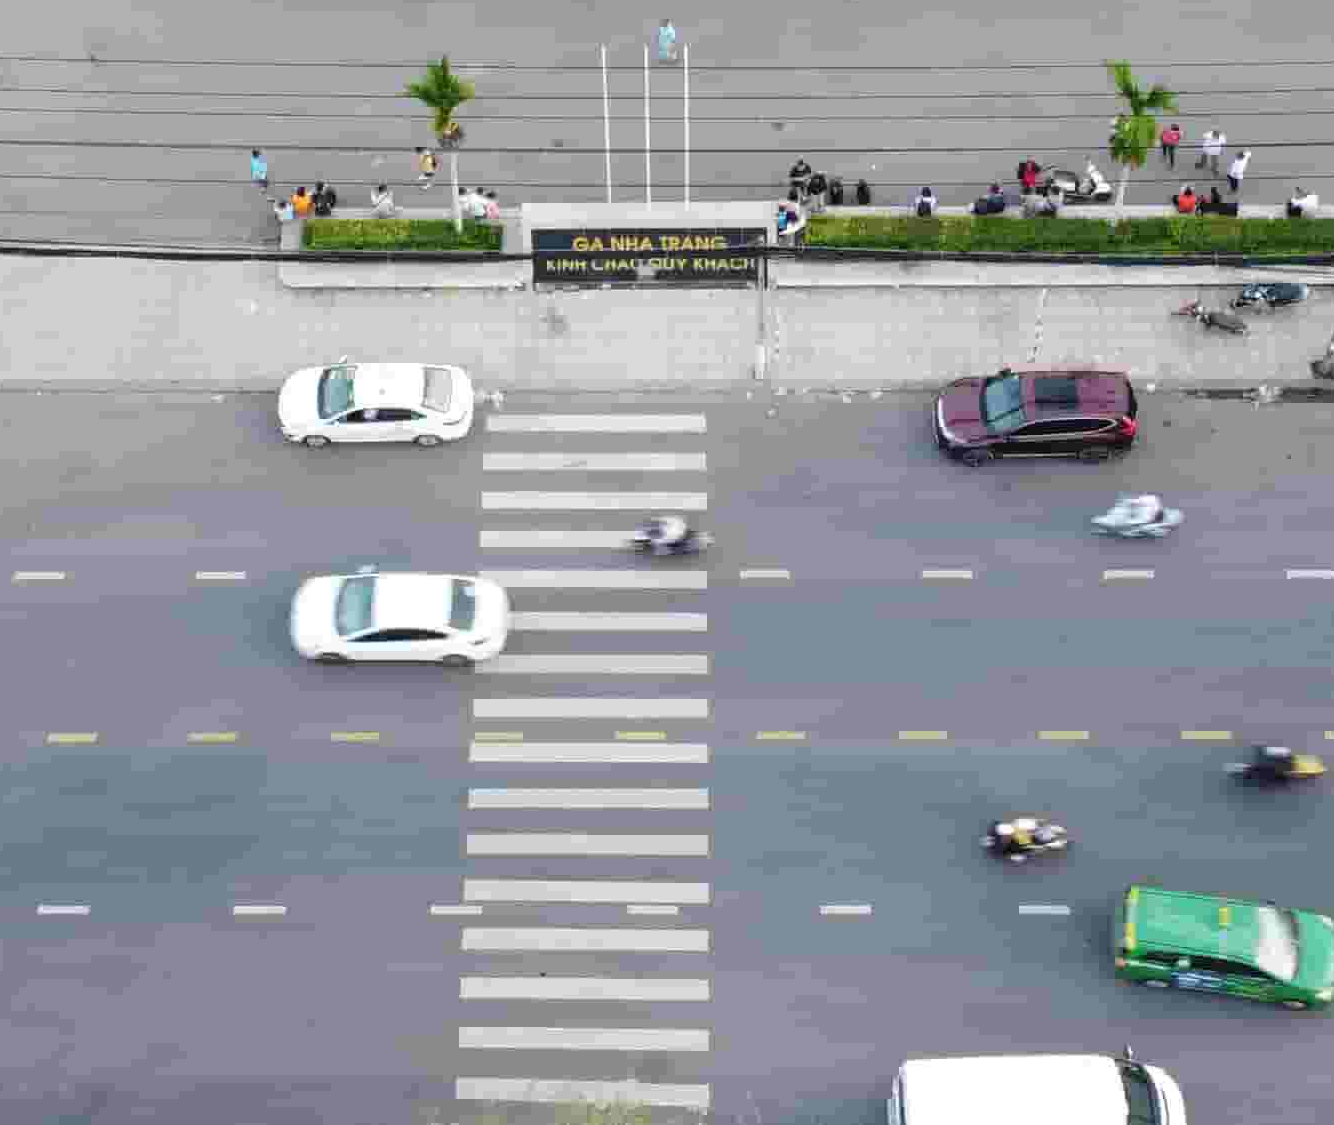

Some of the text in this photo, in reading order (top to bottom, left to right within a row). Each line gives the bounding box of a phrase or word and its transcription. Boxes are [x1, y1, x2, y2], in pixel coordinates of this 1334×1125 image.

[572, 235, 727, 252] GA NHA TRANG
